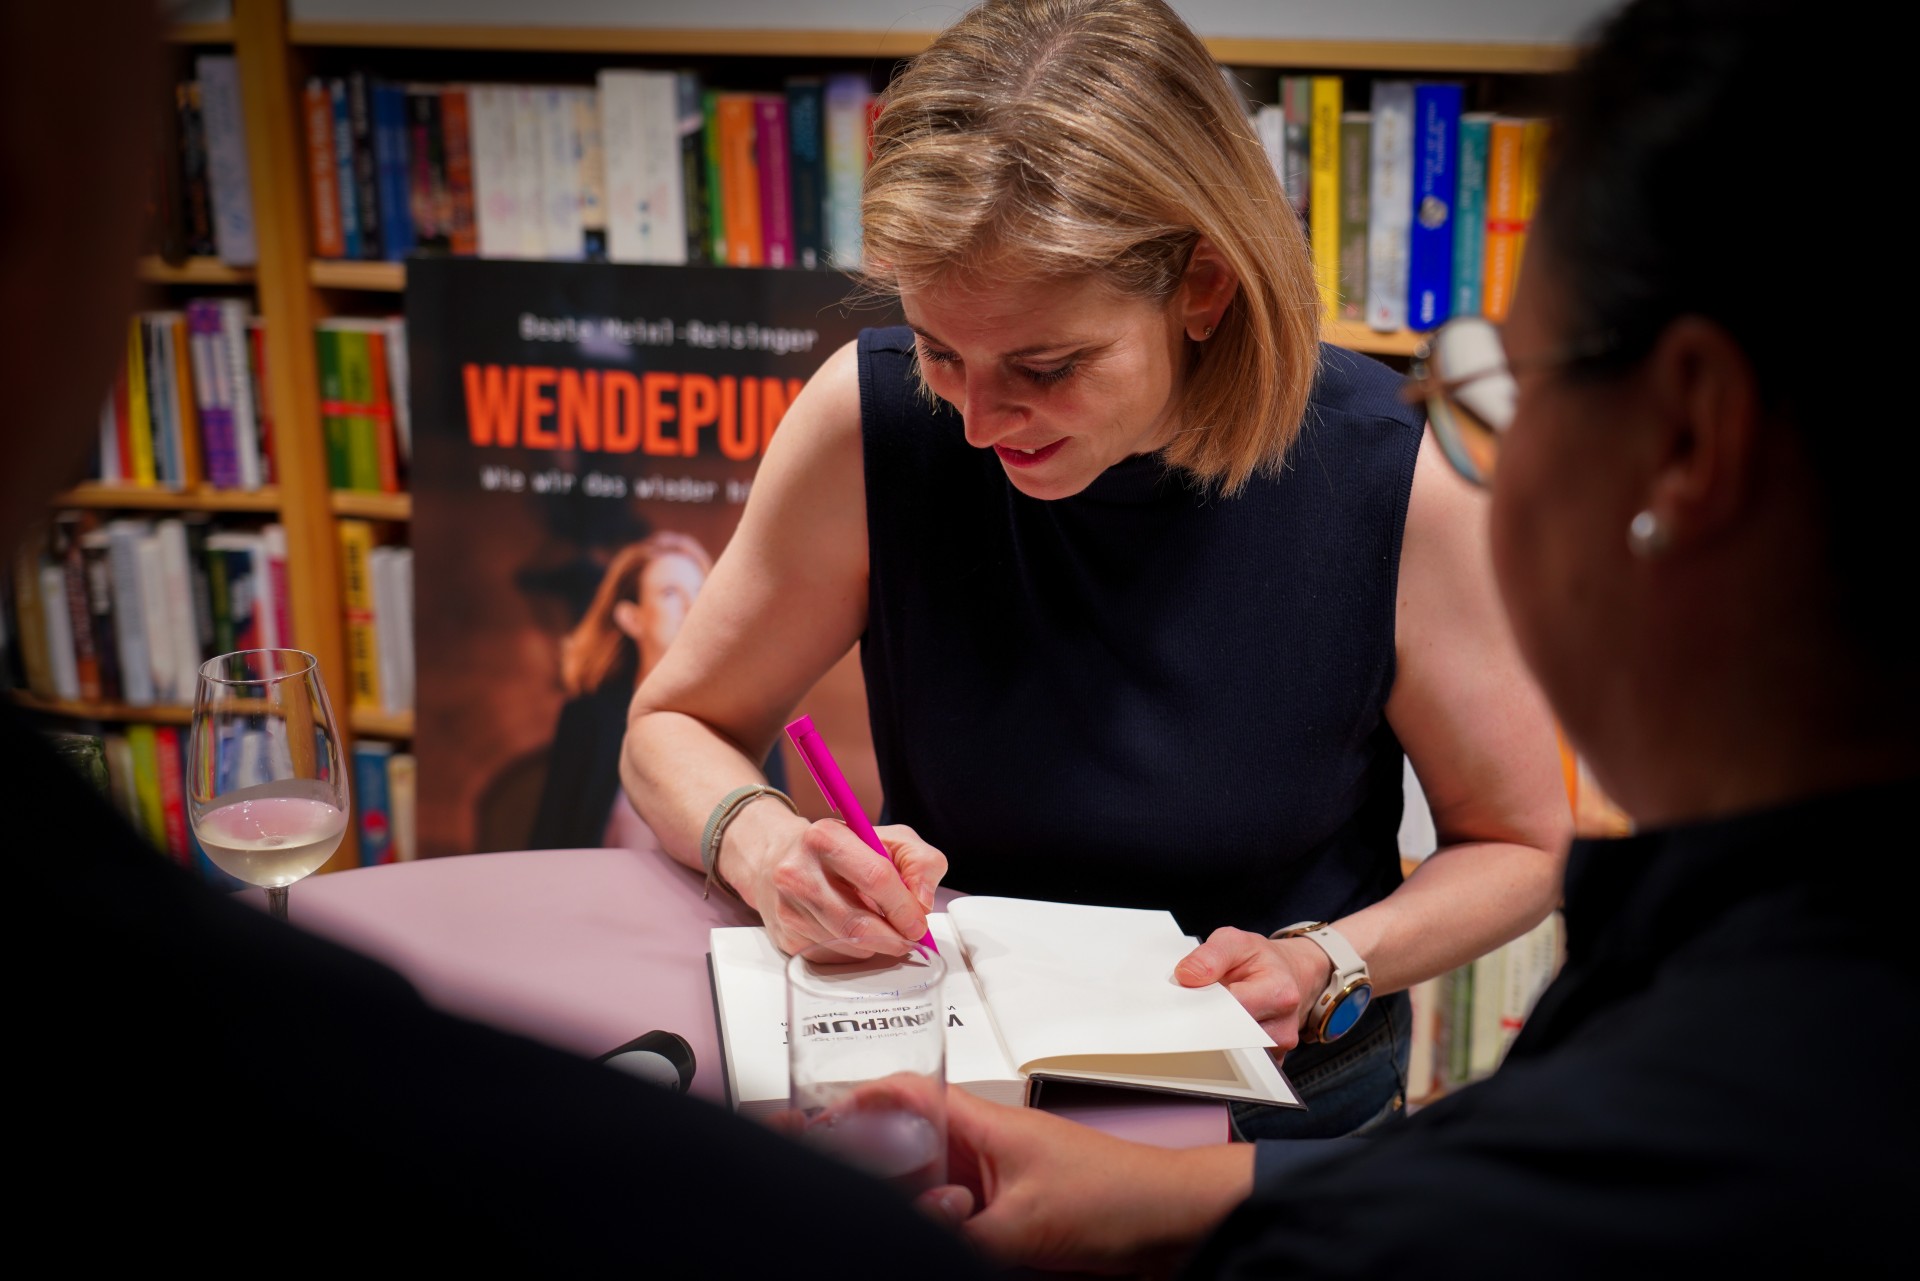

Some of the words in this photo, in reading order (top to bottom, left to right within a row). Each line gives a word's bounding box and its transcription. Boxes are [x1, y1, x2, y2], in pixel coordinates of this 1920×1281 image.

[480, 465, 527, 492] Wie
[531, 468, 576, 493] wir
[583, 470, 627, 498] das
[634, 474, 718, 500] wieder
